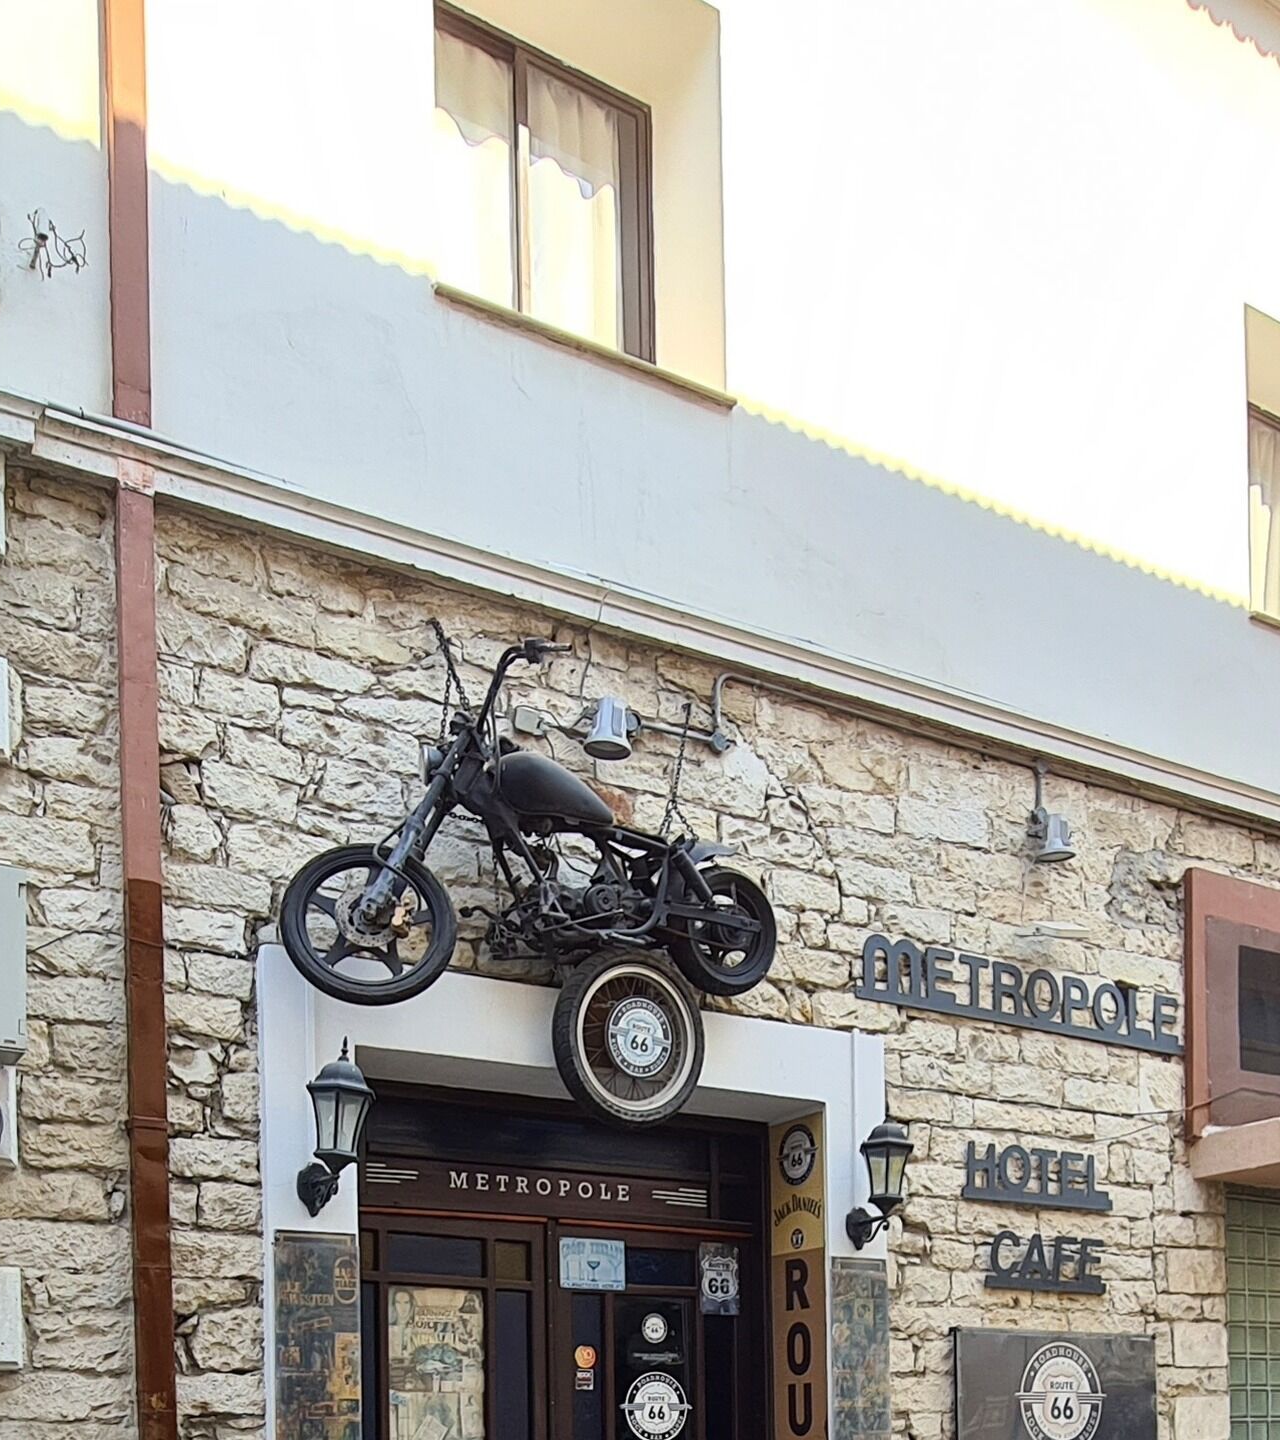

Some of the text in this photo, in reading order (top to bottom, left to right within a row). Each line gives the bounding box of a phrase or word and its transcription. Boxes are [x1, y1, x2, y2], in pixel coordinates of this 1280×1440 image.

[856, 934, 1184, 1053] METROPOLE
[630, 1034, 649, 1053] 66
[791, 1152, 803, 1167] 66
[963, 1140, 1111, 1208] HOTEL
[449, 1171, 630, 1202] METROPOLE
[987, 1230, 1105, 1293] CAFE
[708, 1278, 730, 1295] 66
[1033, 1347, 1090, 1371] ROADHOUSE
[1049, 1381, 1074, 1391] ROUTE
[648, 1405, 665, 1420] 66
[1050, 1397, 1074, 1420] 66
[1025, 1409, 1046, 1440] ROCK
